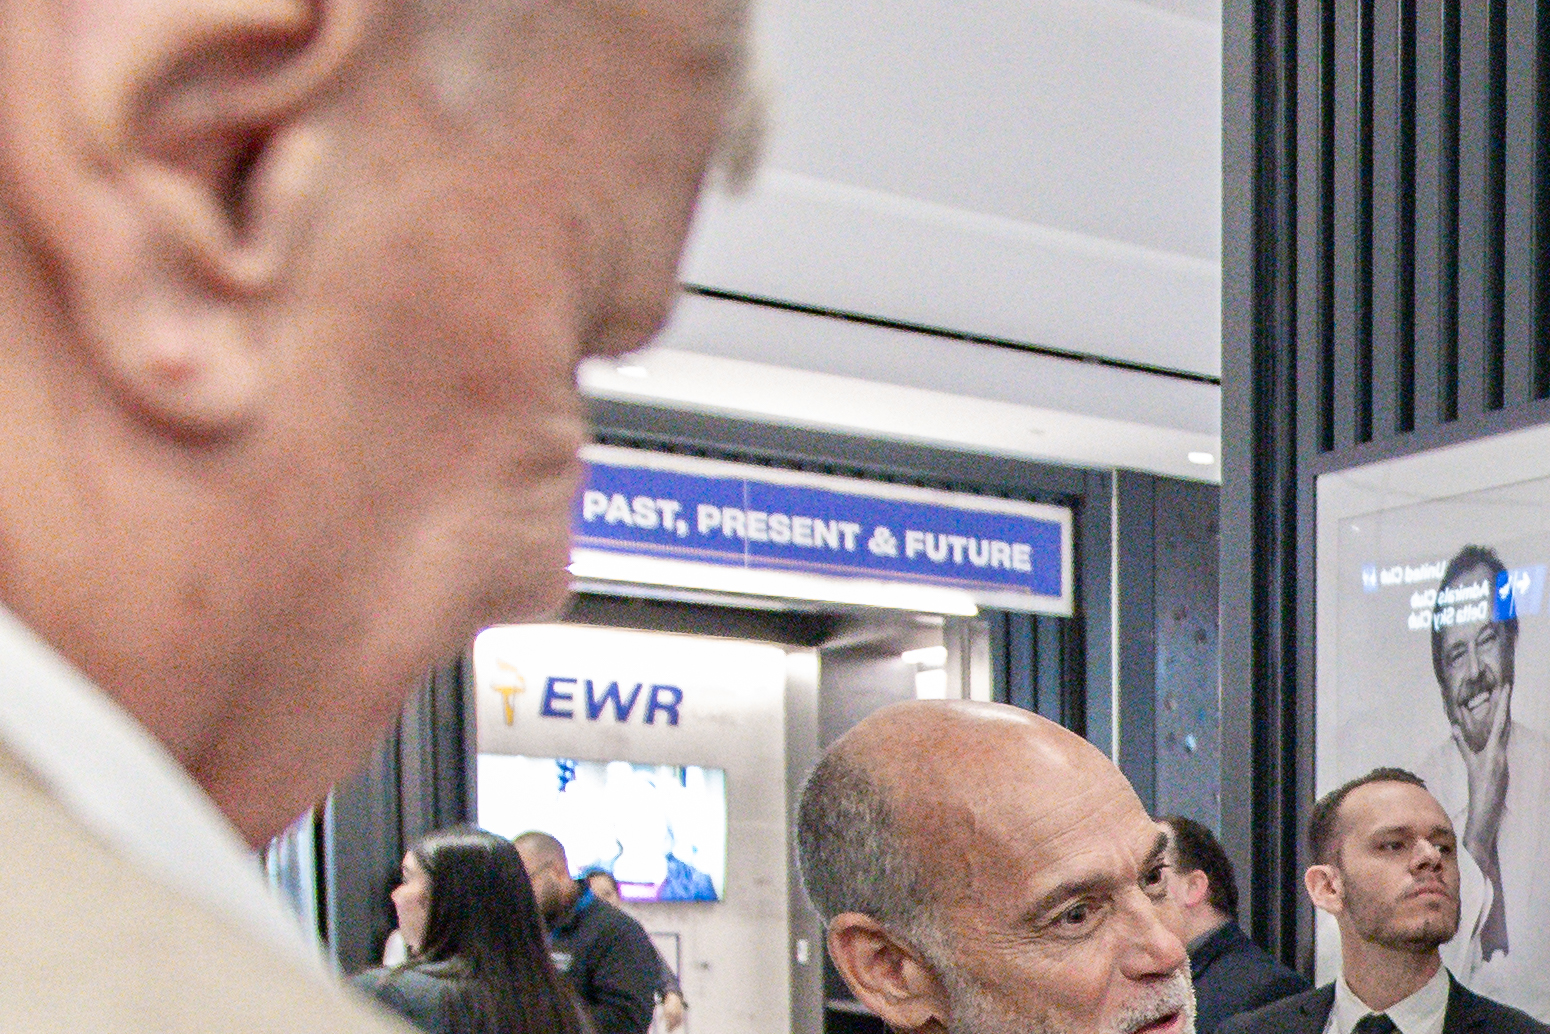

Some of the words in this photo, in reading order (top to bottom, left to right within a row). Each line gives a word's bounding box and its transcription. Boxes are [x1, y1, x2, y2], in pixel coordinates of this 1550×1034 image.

[582, 491, 688, 538] PAST,
[697, 503, 860, 553] PRESENT
[867, 526, 898, 557] &
[905, 529, 1033, 573] FUTURE
[539, 675, 684, 727] EWR
